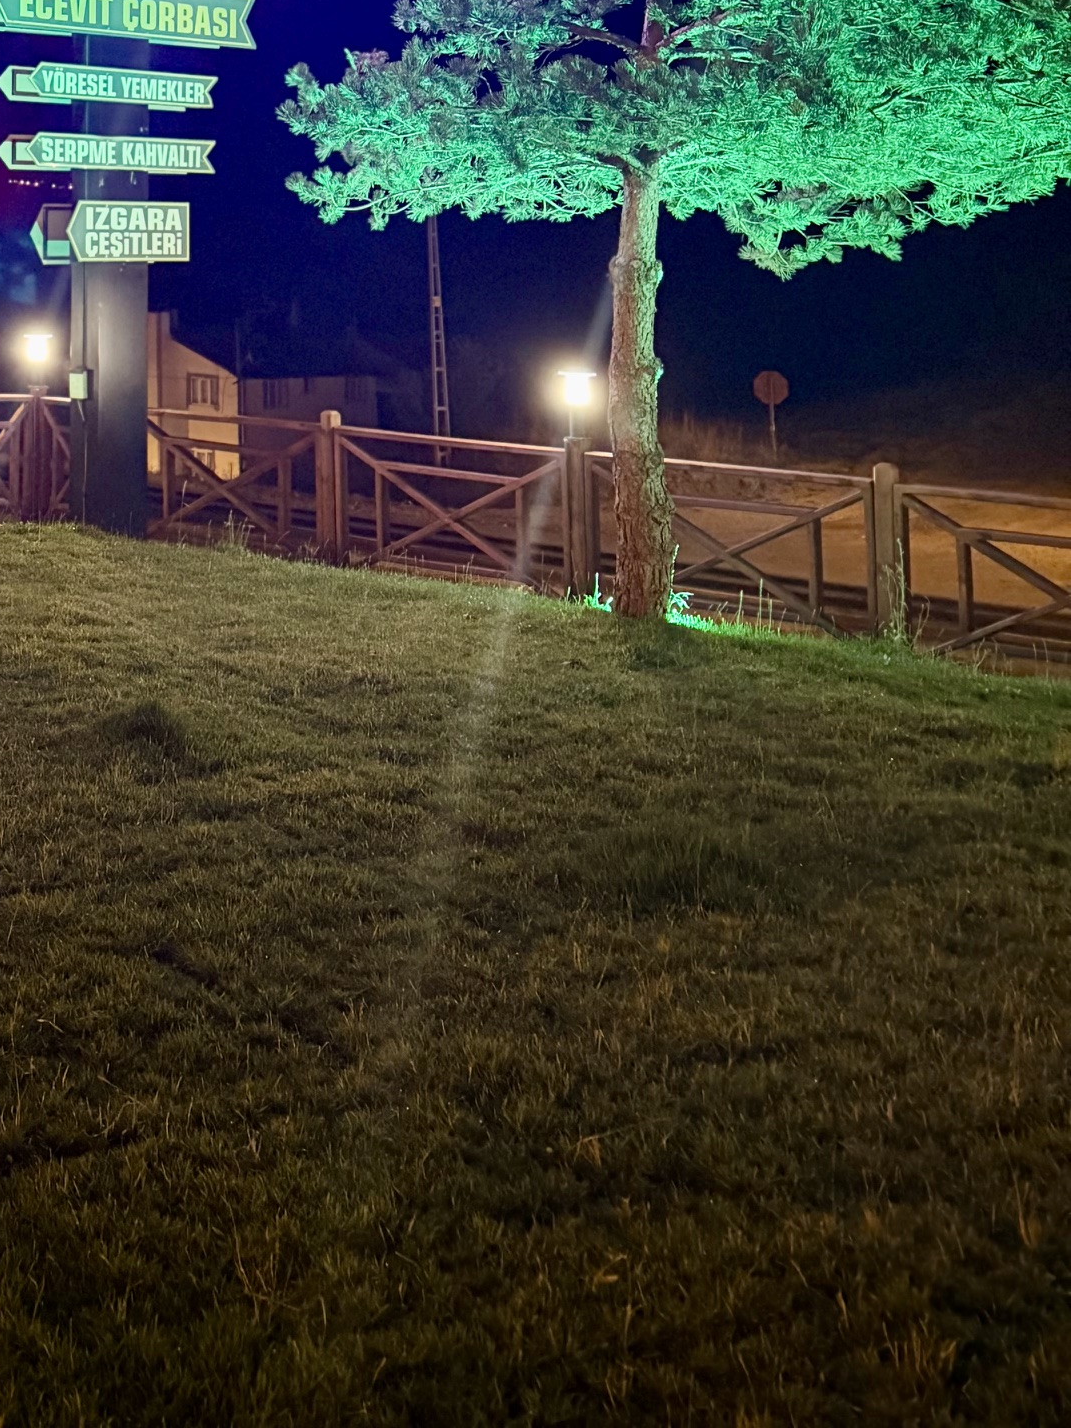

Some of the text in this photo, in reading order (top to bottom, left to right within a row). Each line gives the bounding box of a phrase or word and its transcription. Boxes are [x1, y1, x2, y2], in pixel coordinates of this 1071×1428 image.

[42, 67, 205, 103] YÖRESEL YEMEKLER
[41, 138, 202, 168] SERPME KAHVALTI
[85, 206, 183, 231] IZGARA
